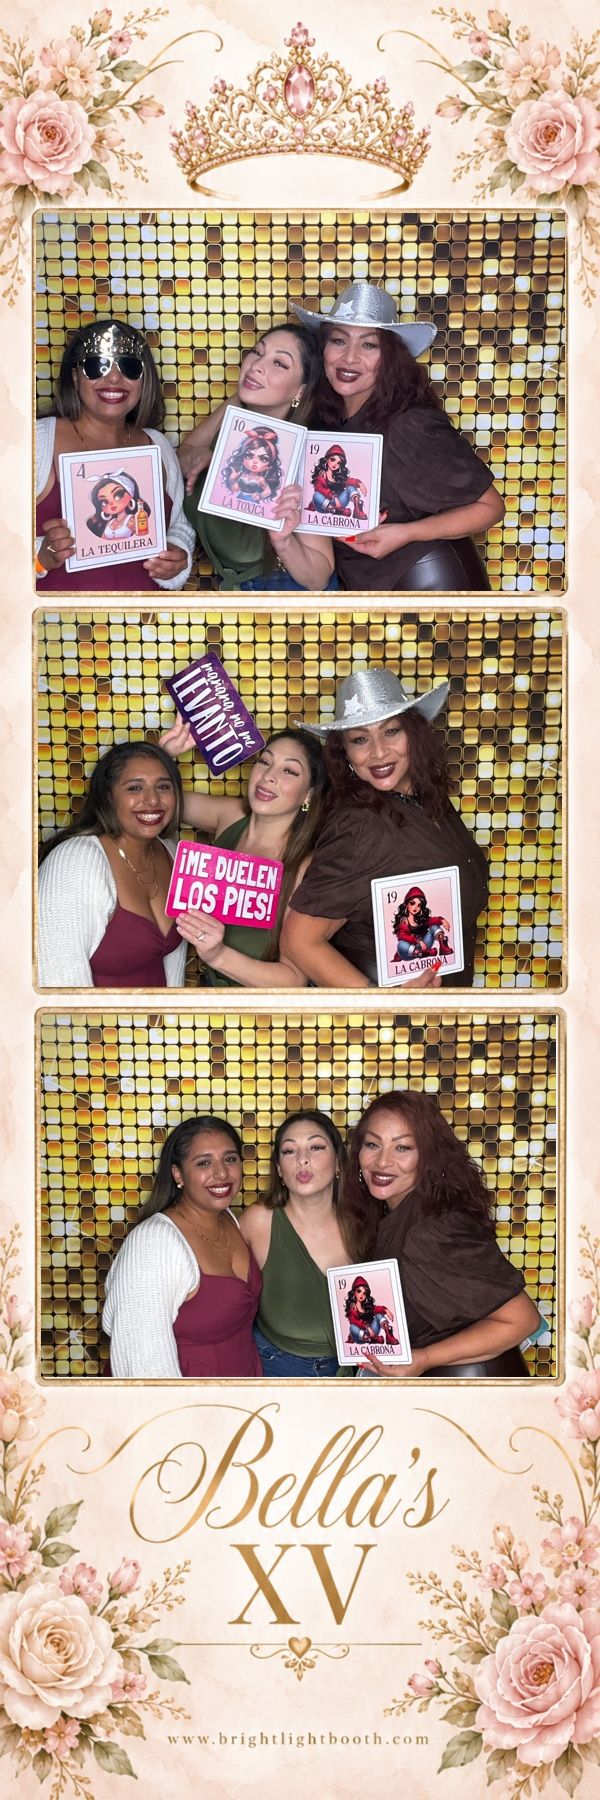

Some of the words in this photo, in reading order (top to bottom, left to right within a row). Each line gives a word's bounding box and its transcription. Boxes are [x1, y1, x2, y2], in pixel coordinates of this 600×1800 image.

[232, 418, 246, 432] 10
[309, 443, 320, 455] 19
[76, 463, 86, 479] 4
[222, 495, 233, 508] LA
[237, 499, 265, 516] TOXICA
[307, 514, 319, 525] LA
[321, 515, 361, 529] CABRONA
[81, 545, 95, 558] LA
[97, 537, 154, 555] TEQUILERA
[171, 666, 244, 767] LEVANTO
[229, 713, 245, 728] no
[238, 731, 256, 748] me
[214, 855, 278, 890] DUELEN
[172, 877, 219, 914] LOS
[222, 885, 274, 922] PIES!
[386, 890, 398, 904] 19
[395, 964, 407, 975] LA
[338, 1279, 347, 1290] 19
[349, 1346, 360, 1356] LA
[360, 1344, 395, 1356] CABRONA
